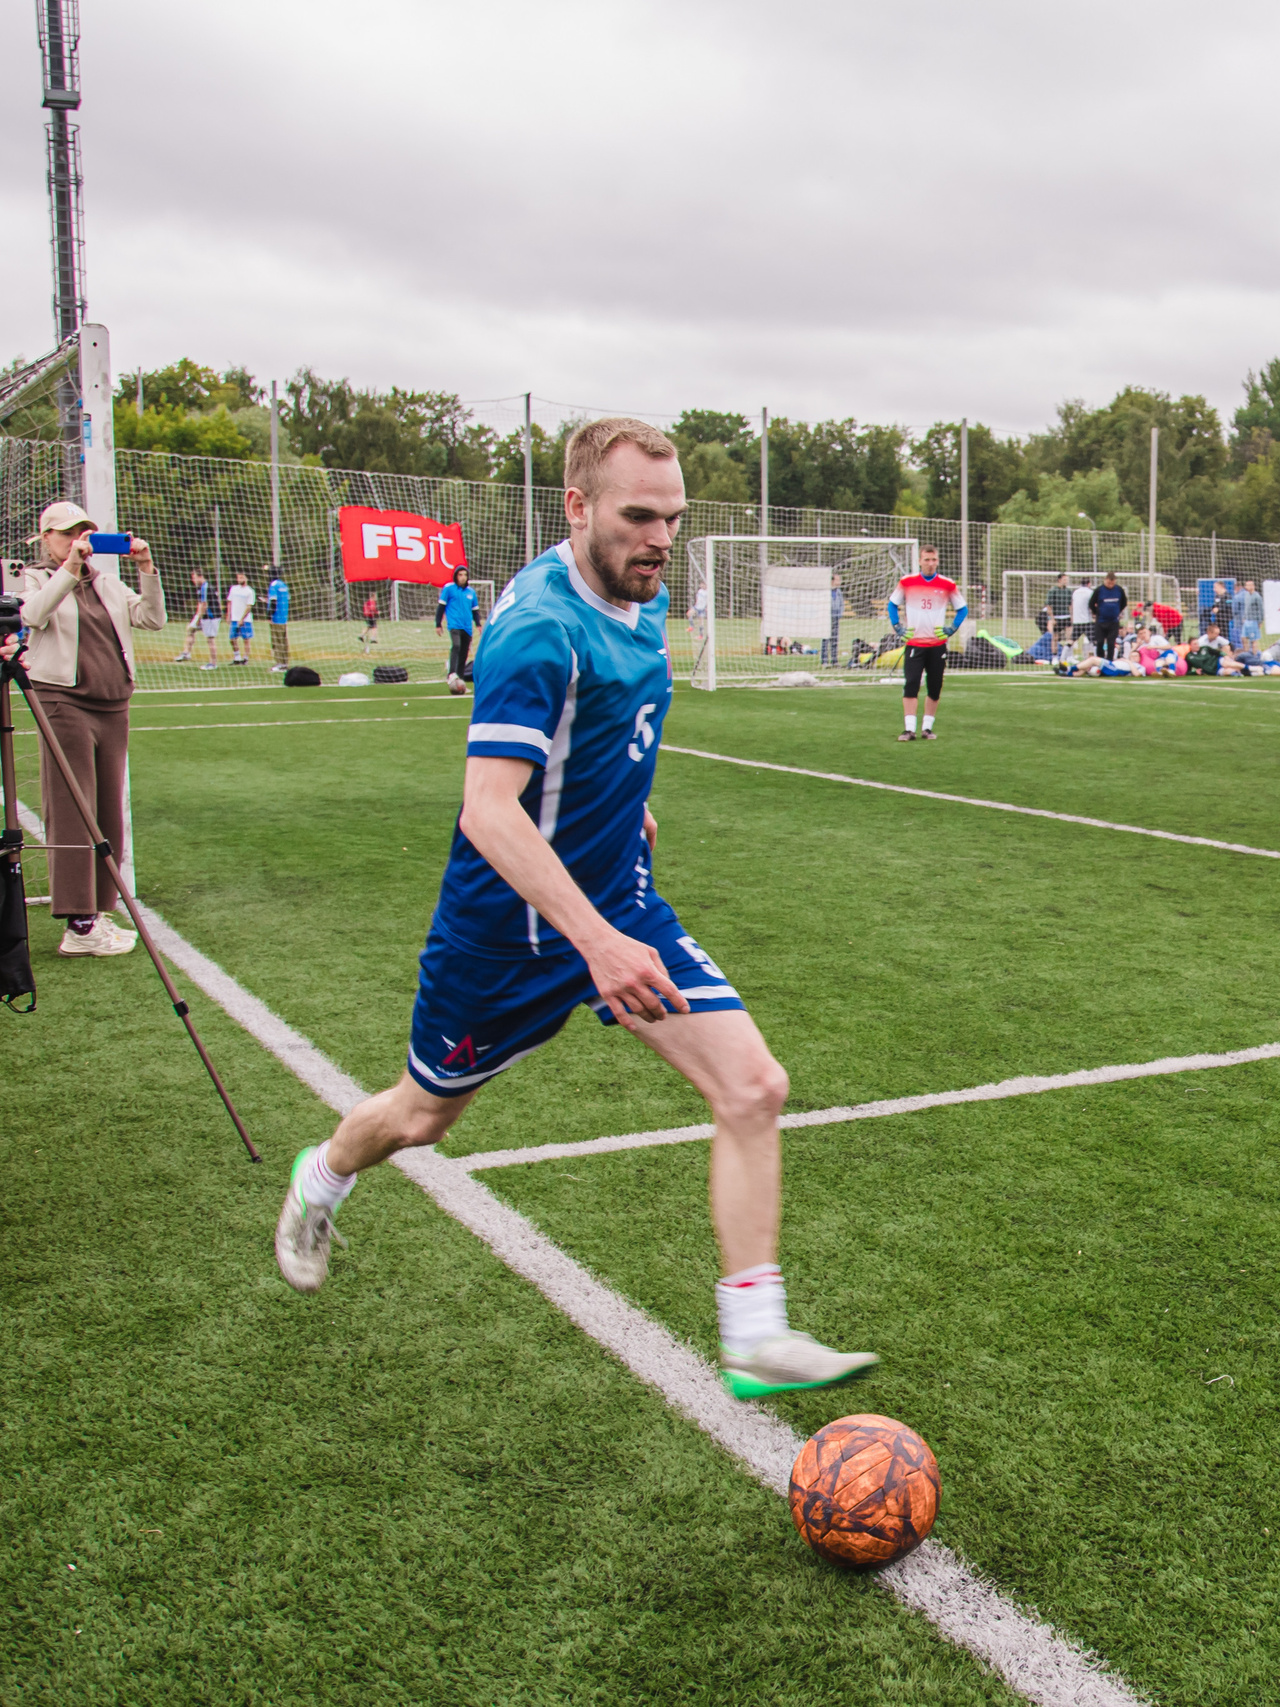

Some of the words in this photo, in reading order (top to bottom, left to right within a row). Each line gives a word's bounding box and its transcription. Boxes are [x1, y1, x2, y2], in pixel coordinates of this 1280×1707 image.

[921, 599, 932, 610] 35
[628, 703, 656, 762] 5
[676, 936, 727, 980] 5
